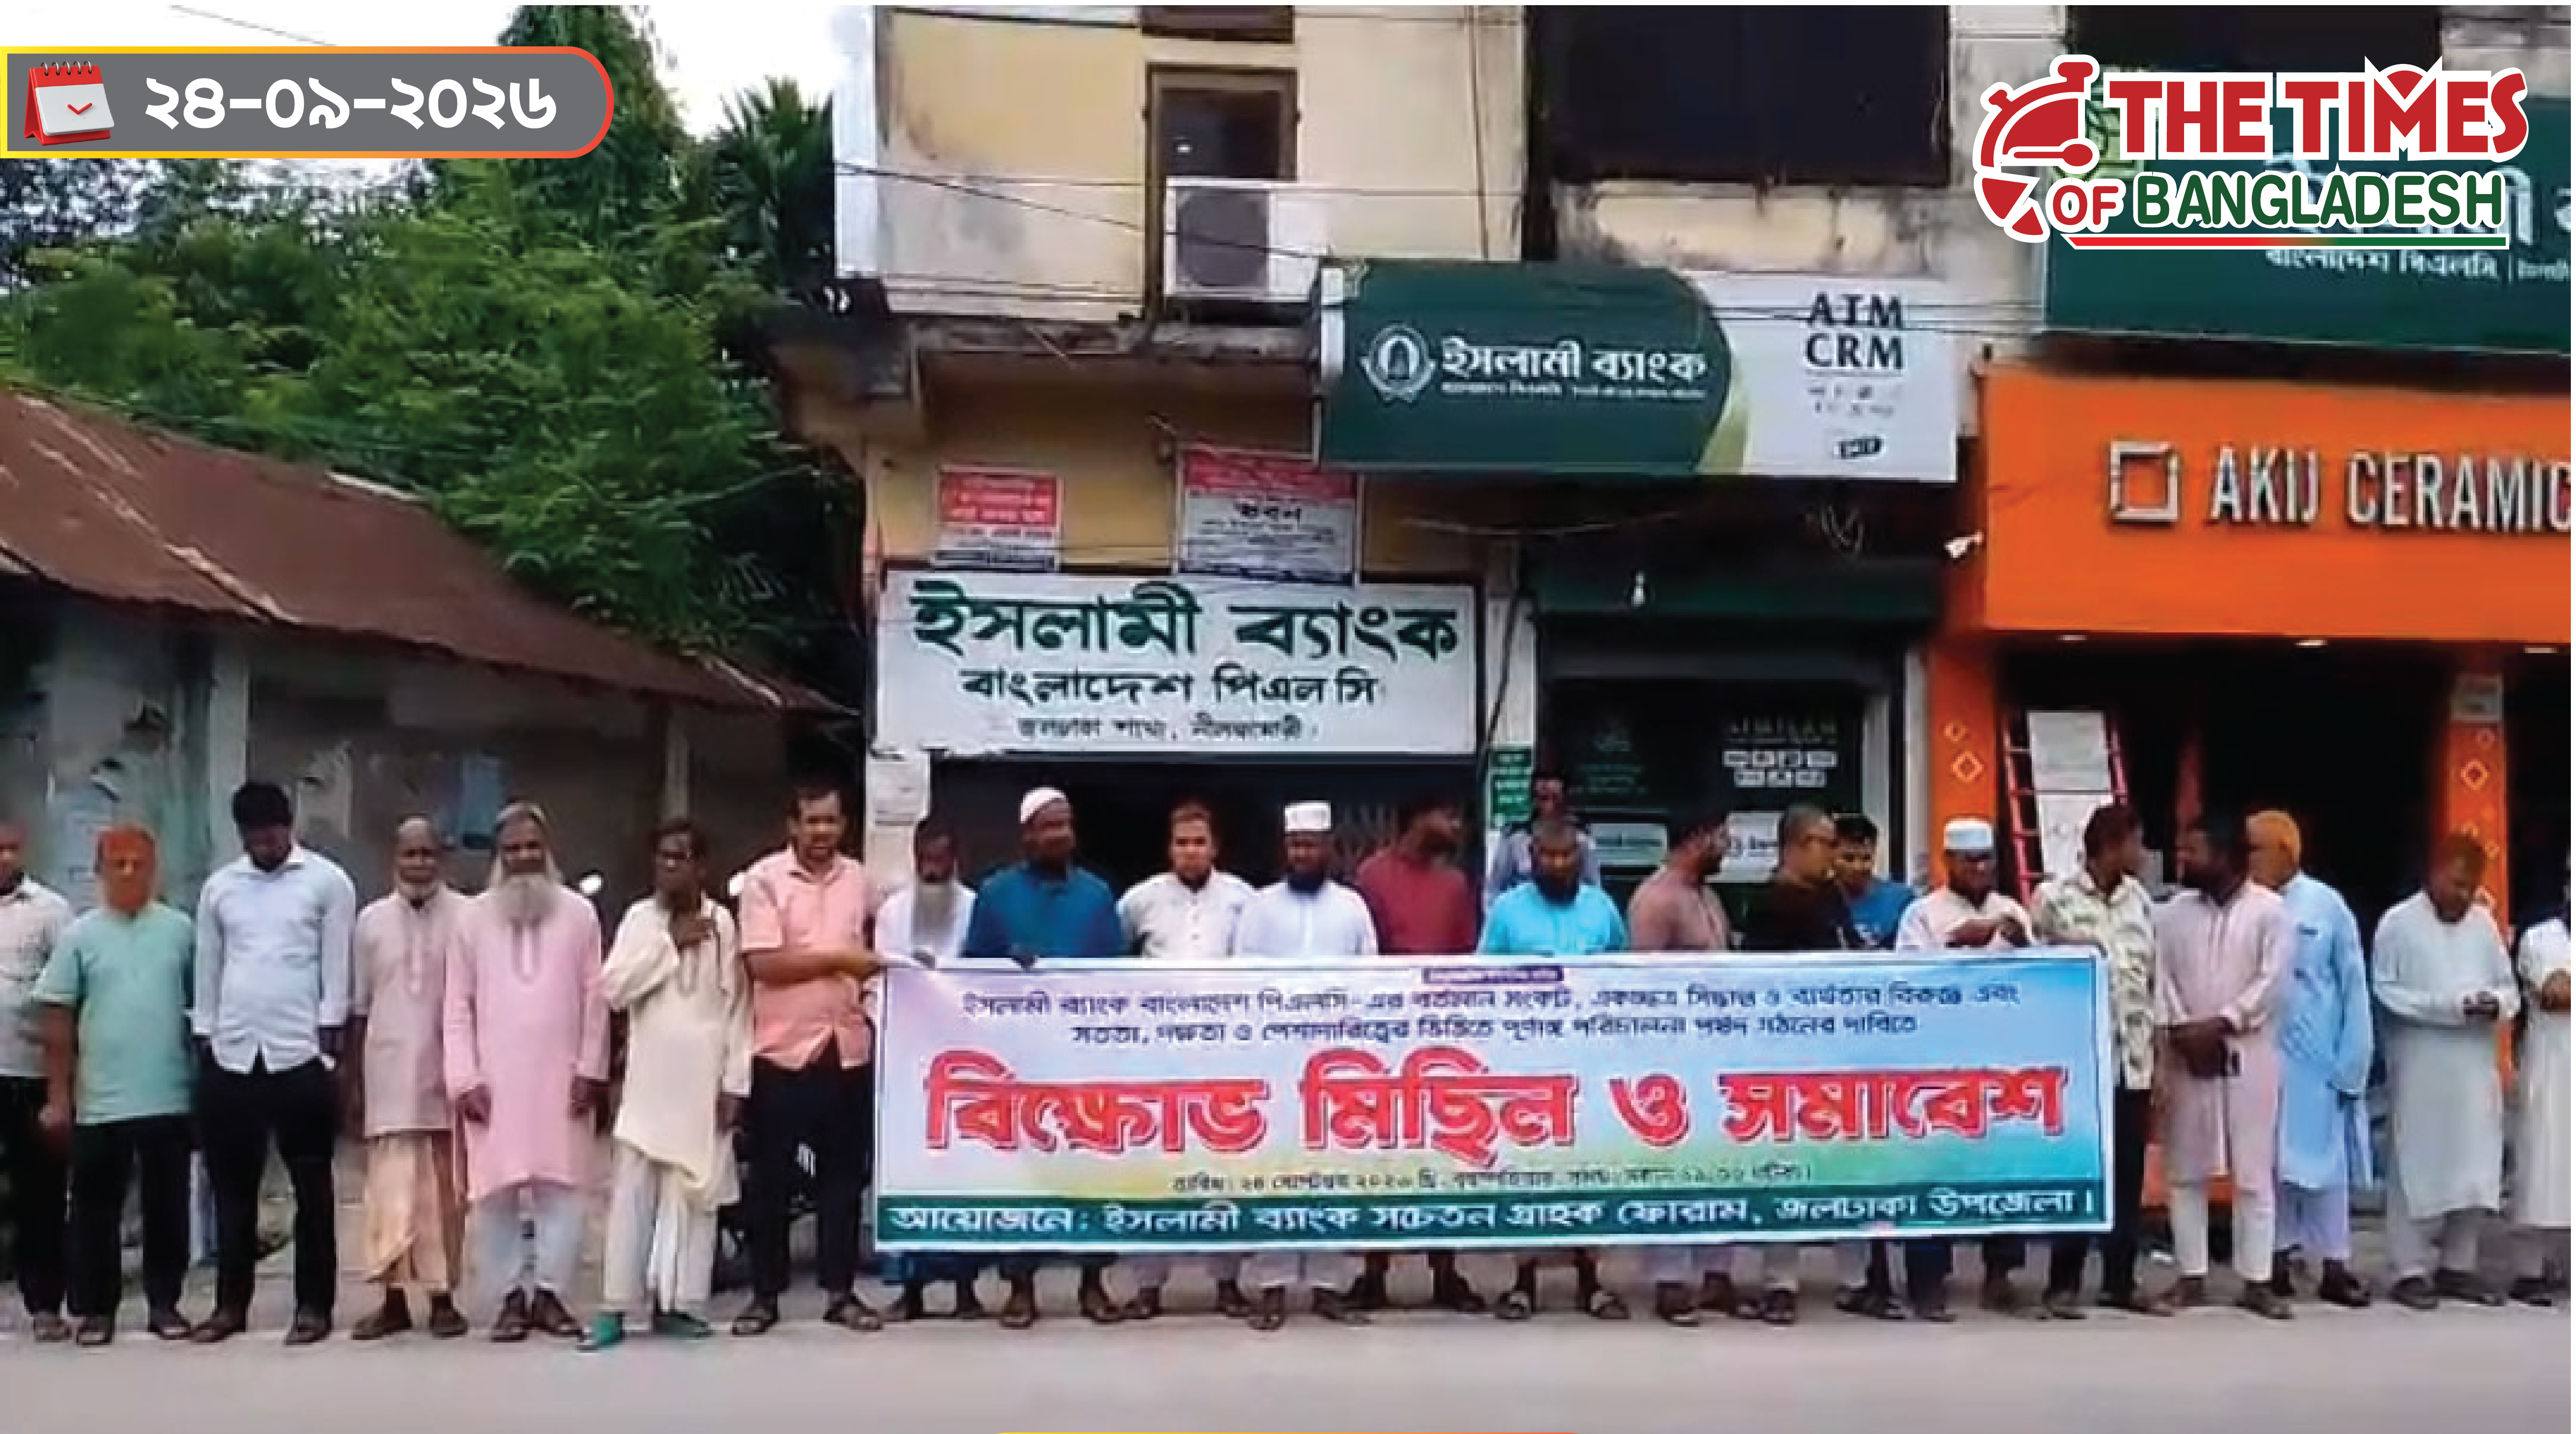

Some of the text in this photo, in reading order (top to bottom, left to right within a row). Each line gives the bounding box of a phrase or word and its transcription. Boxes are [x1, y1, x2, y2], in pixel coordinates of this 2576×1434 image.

[1808, 293, 1902, 329] ATM
[1442, 337, 1708, 380] ইসলামী ব্যাংক
[1806, 336, 1904, 369] CRM
[2211, 447, 2318, 523] AKIJ
[910, 580, 1458, 660] ইসলামী ব্যাংক
[960, 666, 1194, 705] বাংলাদেশ
[925, 1047, 2070, 1169] বিক্ষোভ মিছিল ও সমাবেশ
[1103, 1201, 1240, 1232] ইসলামী
[1254, 1208, 1359, 1231] ব্যাংক
[1372, 1205, 1496, 1229] সচেতন
[1507, 1202, 1605, 1228] গ্রাহক
[1617, 1200, 1763, 1227] ফোরাম,
[1775, 1199, 1917, 1220] জলঢাকা
